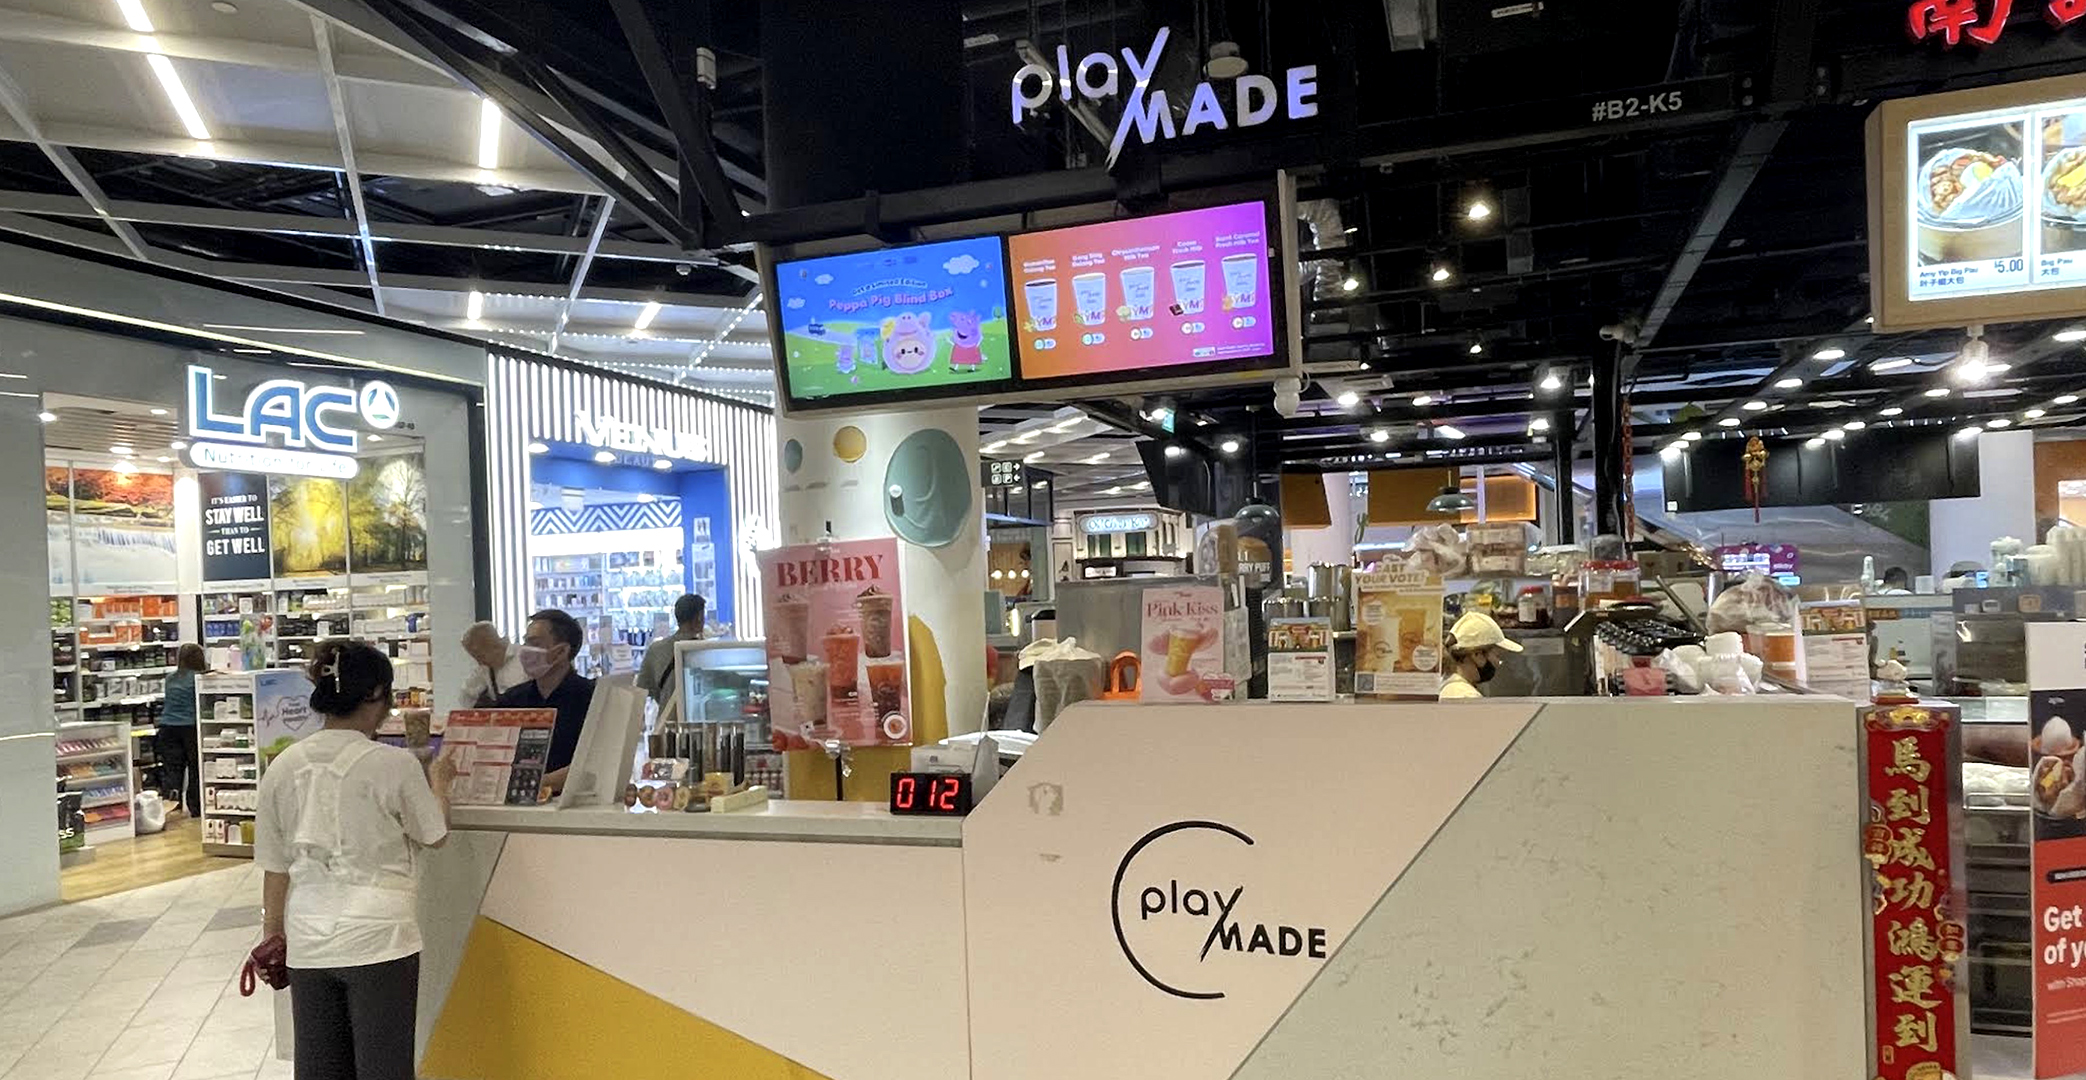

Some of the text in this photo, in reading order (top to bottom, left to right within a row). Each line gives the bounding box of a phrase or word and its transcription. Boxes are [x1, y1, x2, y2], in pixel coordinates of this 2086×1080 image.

[1012, 26, 1170, 171] play
[1131, 64, 1319, 144] MADE
[1592, 91, 1682, 121] #B2-K5
[829, 287, 954, 313] Peppa Pig Blind Box
[189, 366, 357, 452] LAC
[248, 494, 258, 502] TO
[205, 505, 265, 525] STAY WELL
[221, 526, 250, 535] THAN TO
[206, 536, 266, 556] GET WELL
[776, 554, 883, 587] BERRY
[1355, 573, 1387, 585] YOUR
[1147, 601, 1219, 618] Pink Kiss
[896, 777, 959, 810] 012
[1885, 735, 1942, 1053] 馬到成功鴻運到
[1141, 879, 1244, 962] play
[2043, 904, 2083, 932] Get
[1217, 922, 1327, 959] MADE
[2043, 937, 2086, 968] of y
